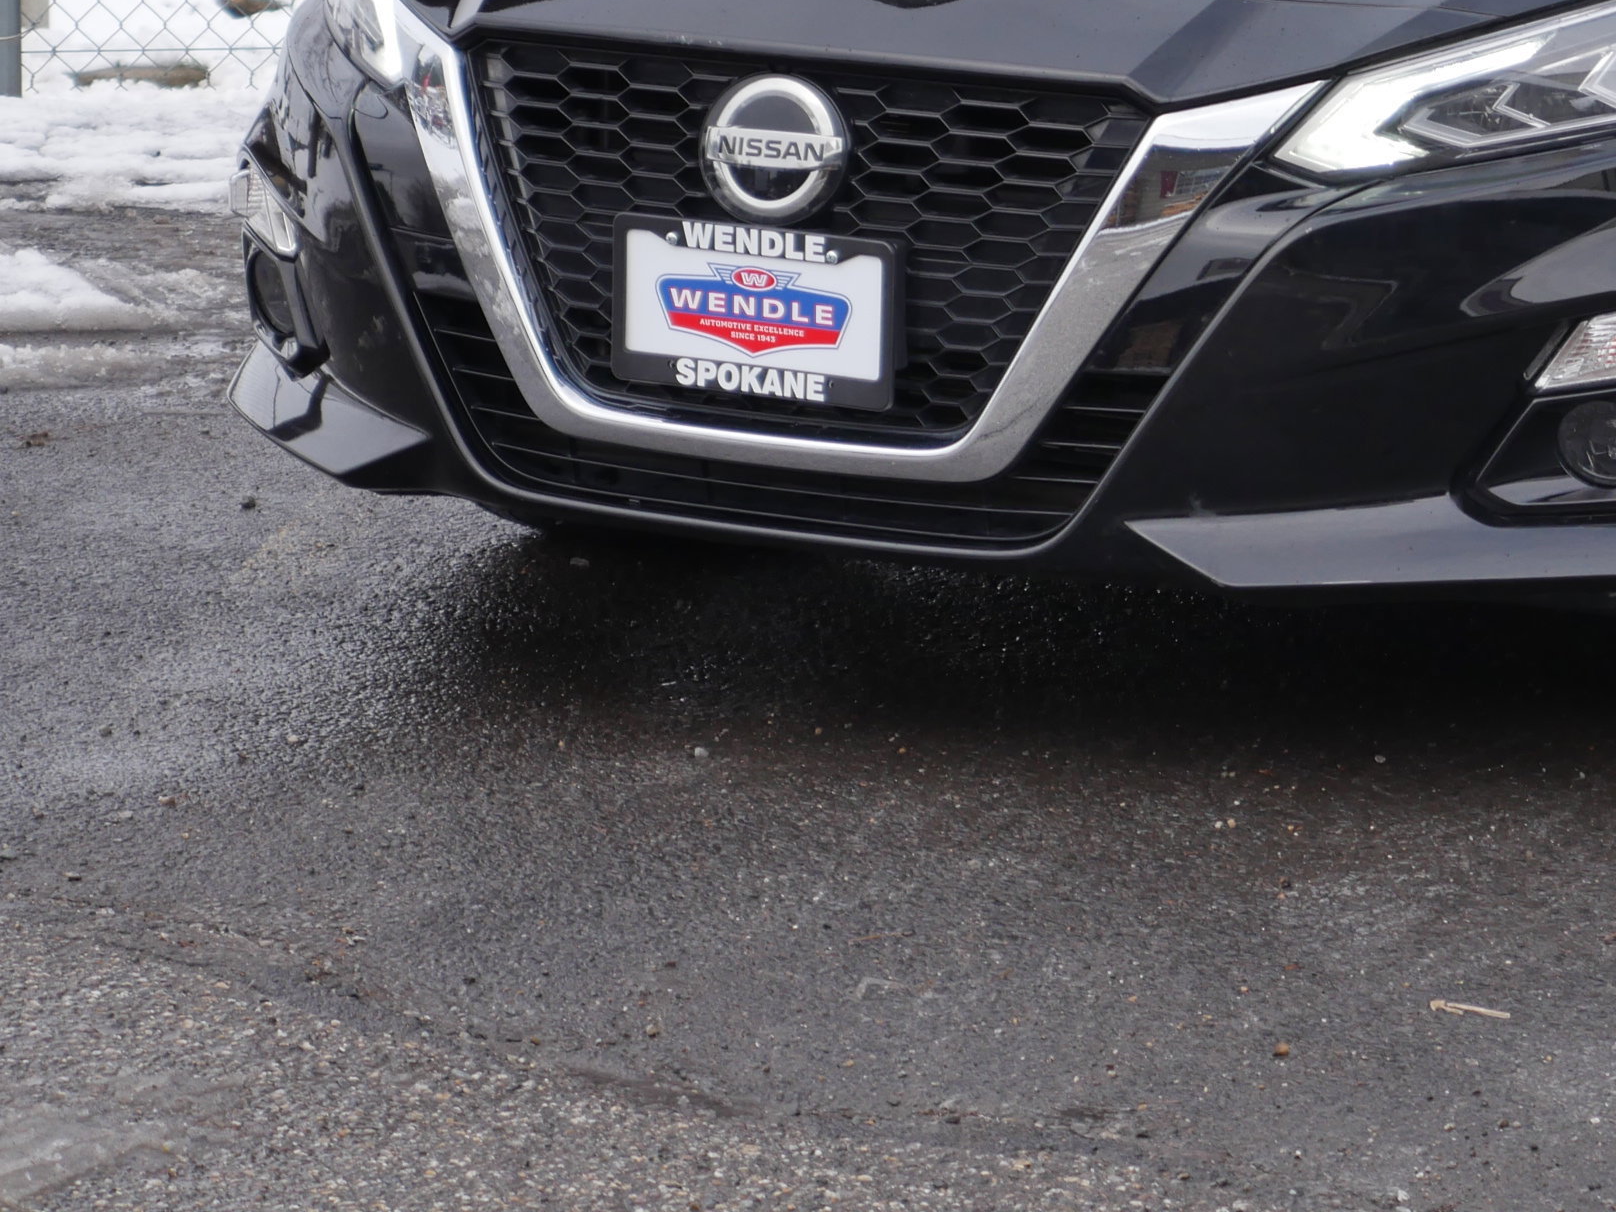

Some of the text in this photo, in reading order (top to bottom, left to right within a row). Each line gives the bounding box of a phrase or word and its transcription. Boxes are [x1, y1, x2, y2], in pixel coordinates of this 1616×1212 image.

[718, 134, 825, 162] NISSAN
[682, 221, 827, 263] WENDLE
[670, 287, 833, 325] WENDLE
[699, 318, 805, 337] AUTOMOTIVE EXCELLENCE
[730, 331, 776, 343] SINCE 1943
[675, 357, 825, 402] SPOKANE
